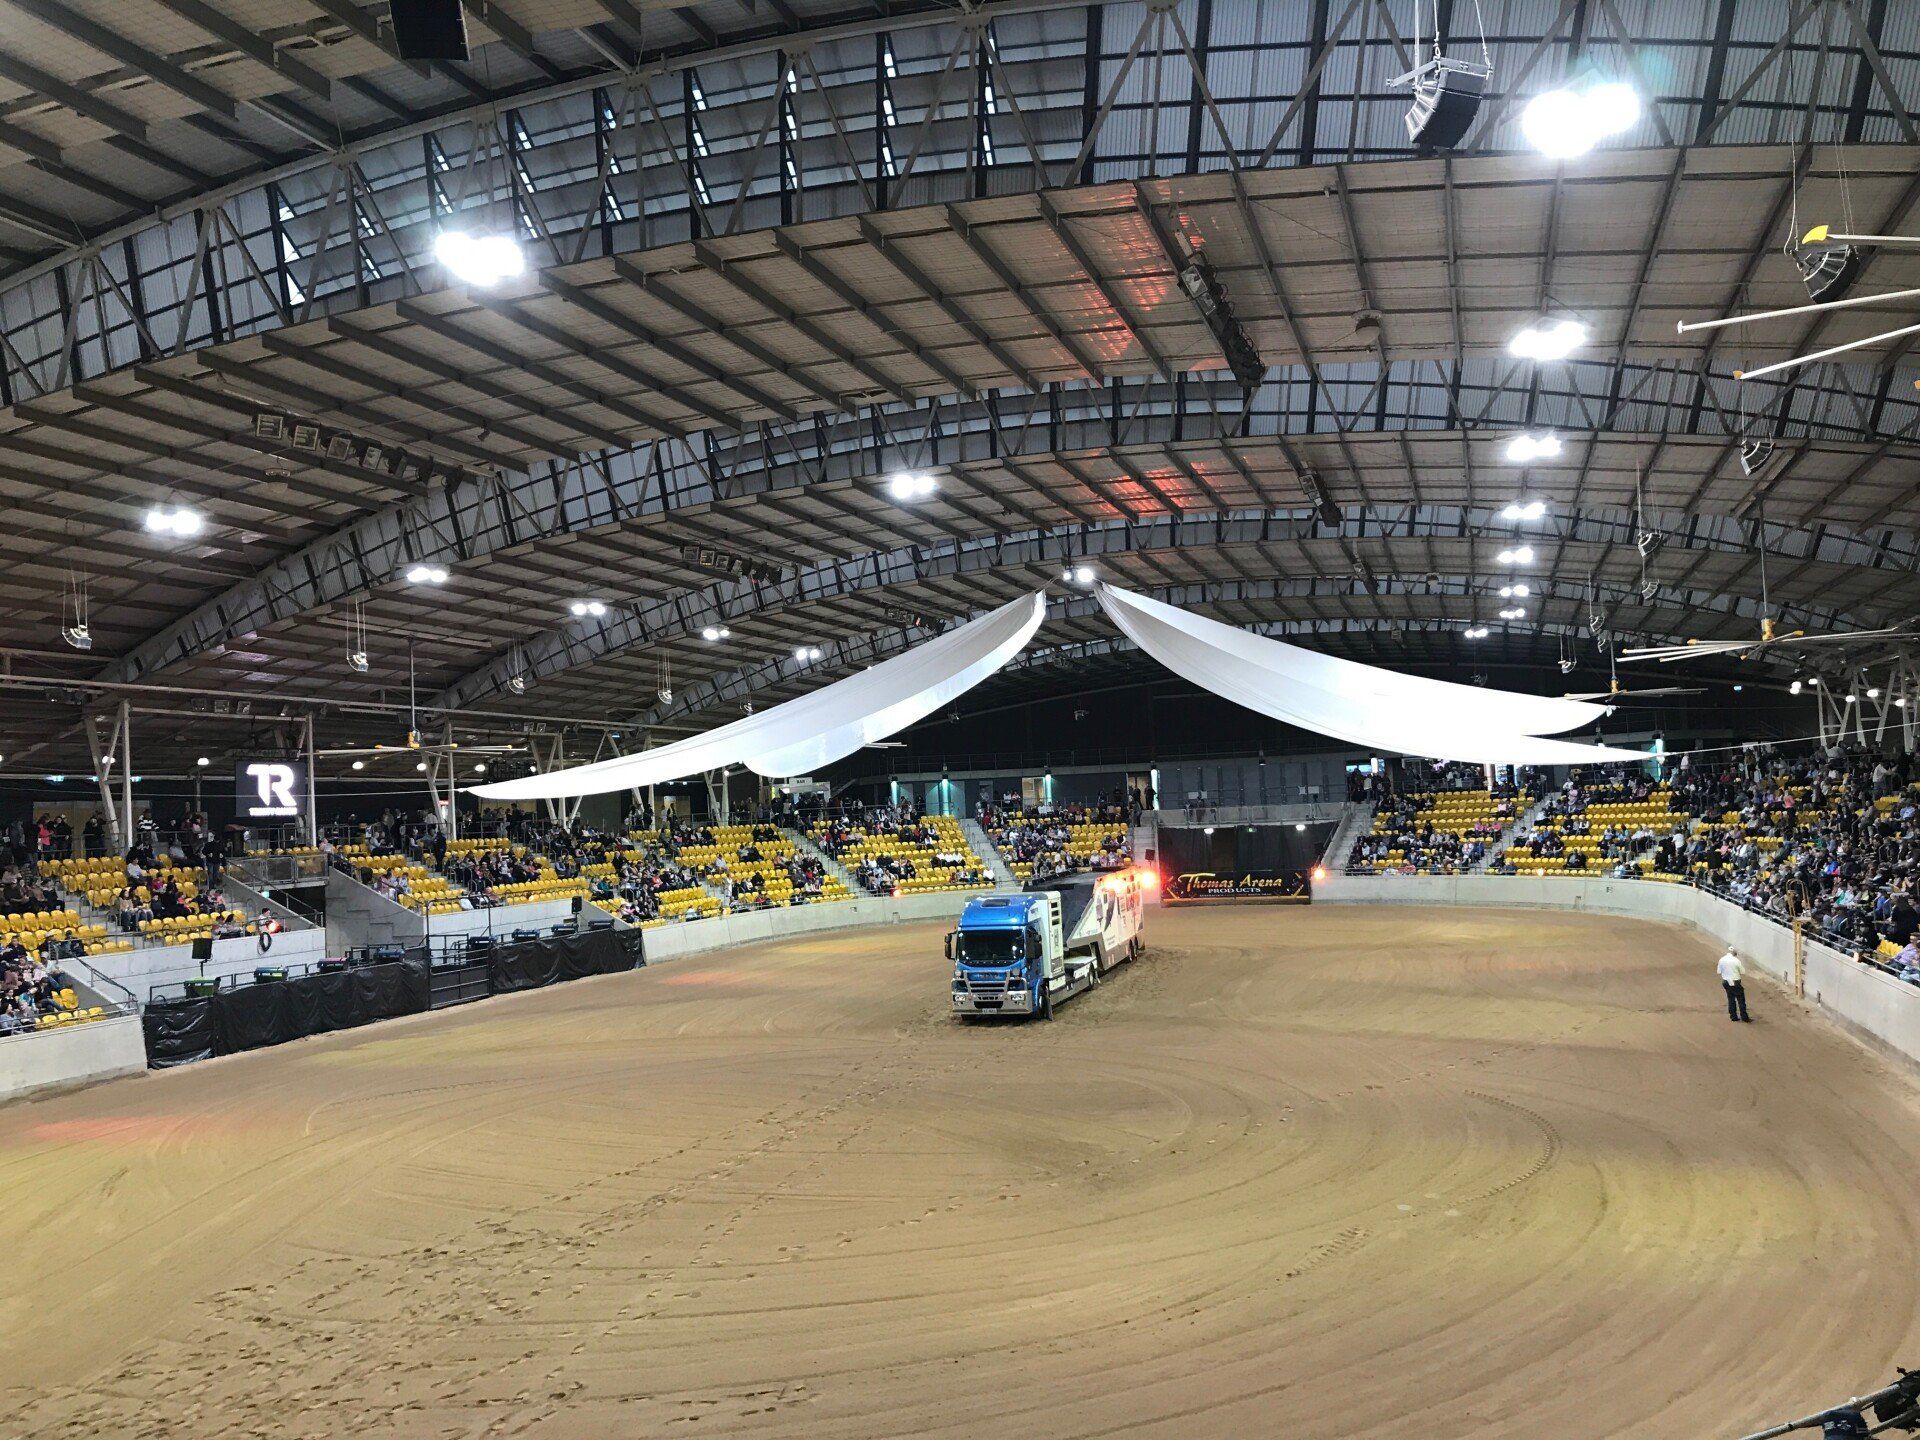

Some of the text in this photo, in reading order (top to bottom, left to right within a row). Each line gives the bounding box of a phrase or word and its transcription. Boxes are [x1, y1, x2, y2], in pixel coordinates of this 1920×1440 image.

[246, 763, 298, 807] TR
[1177, 872, 1282, 892] Thomas Arena
